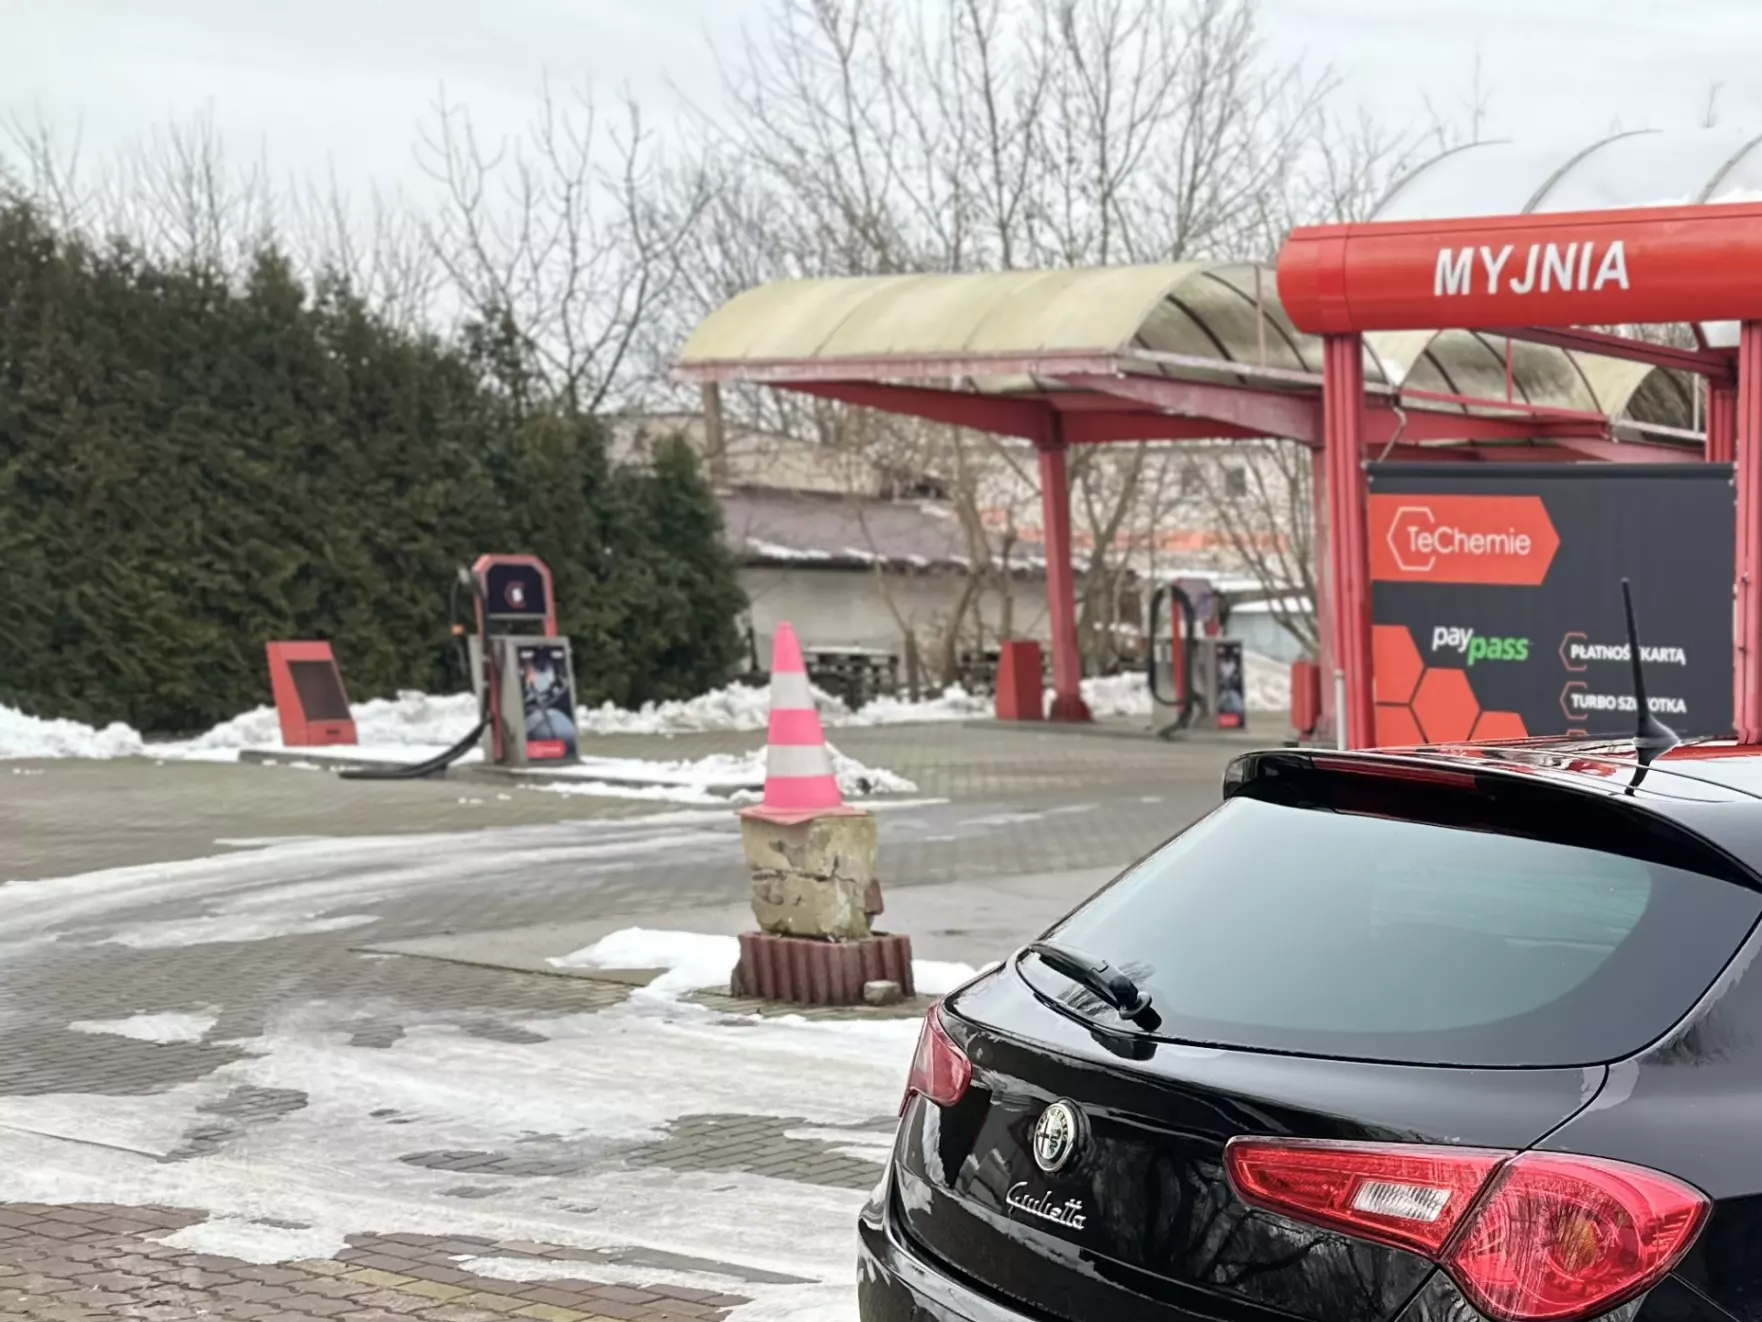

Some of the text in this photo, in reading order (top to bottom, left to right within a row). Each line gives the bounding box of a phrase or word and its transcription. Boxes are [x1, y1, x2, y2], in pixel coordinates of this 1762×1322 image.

[1433, 240, 1630, 297] MYJNIA
[1406, 524, 1532, 555] TeChemie
[1570, 643, 1687, 666] PŁATNOŚ KARTĄ
[1570, 693, 1687, 714] TURBO SZOTKA
[1006, 1181, 1087, 1230] Giulietta
